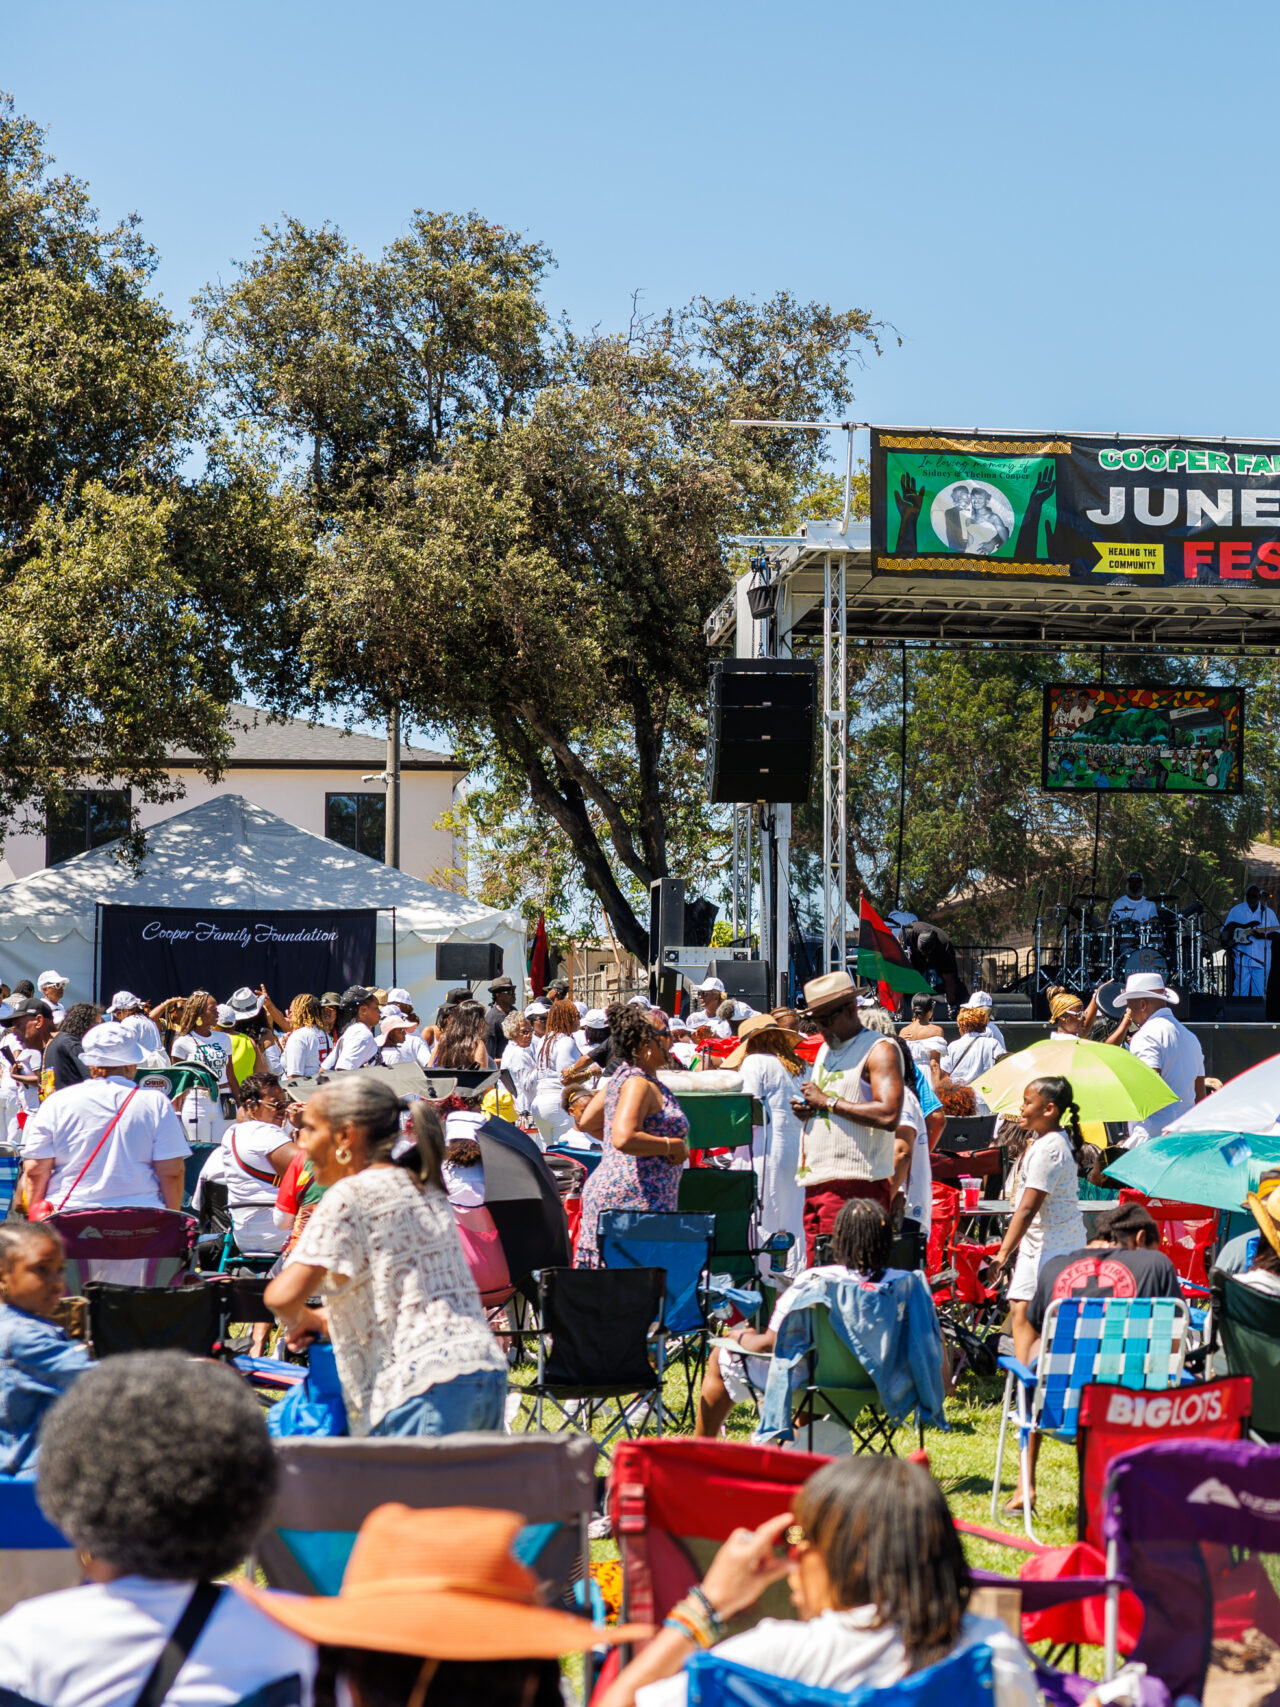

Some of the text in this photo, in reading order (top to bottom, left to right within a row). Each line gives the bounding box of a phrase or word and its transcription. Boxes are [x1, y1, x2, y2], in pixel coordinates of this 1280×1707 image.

[936, 457, 968, 472] loving
[1098, 448, 1233, 474] COOPER
[922, 470, 951, 478] Sidney
[966, 471, 996, 479] Thelma
[1000, 472, 1031, 480] Cooper
[1108, 547, 1157, 558] HEALING THE
[1109, 560, 1156, 570] COMMUNITY
[142, 921, 339, 948] Cooper Family Foundation
[194, 1049, 228, 1062] NVER
